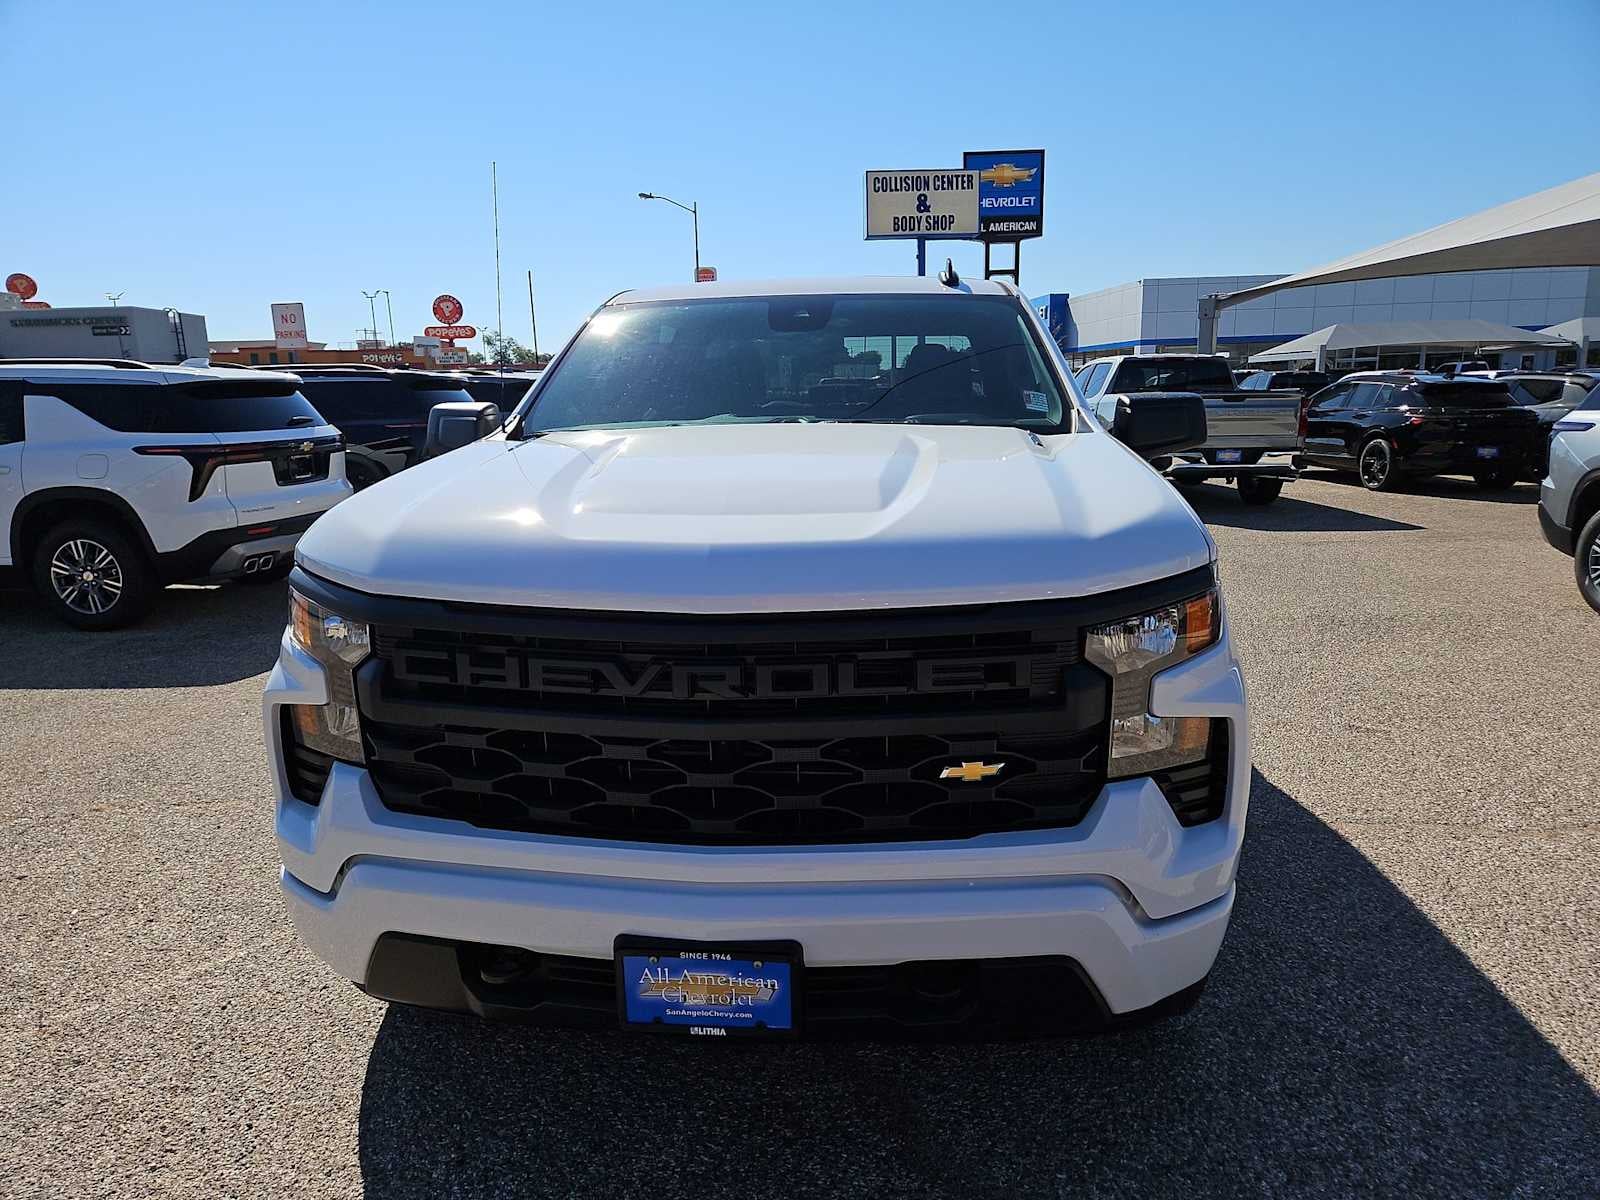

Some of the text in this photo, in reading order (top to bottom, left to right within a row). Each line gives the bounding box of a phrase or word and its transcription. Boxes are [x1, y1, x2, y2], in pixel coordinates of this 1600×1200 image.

[873, 173, 974, 193] COLLISION CENTER
[916, 193, 931, 213] &
[980, 196, 1036, 208] HEVROLET
[893, 214, 955, 232] BODY SHOP
[989, 221, 1037, 232] AMERICAN
[281, 313, 297, 324] NO
[276, 330, 305, 339] PARKING
[394, 649, 1033, 699] CHEVROLET
[680, 951, 732, 961] SINCE 1946
[638, 967, 779, 990] All American
[661, 986, 755, 1006] Chevrolet
[666, 1008, 753, 1019] SanAngeloChevy.com
